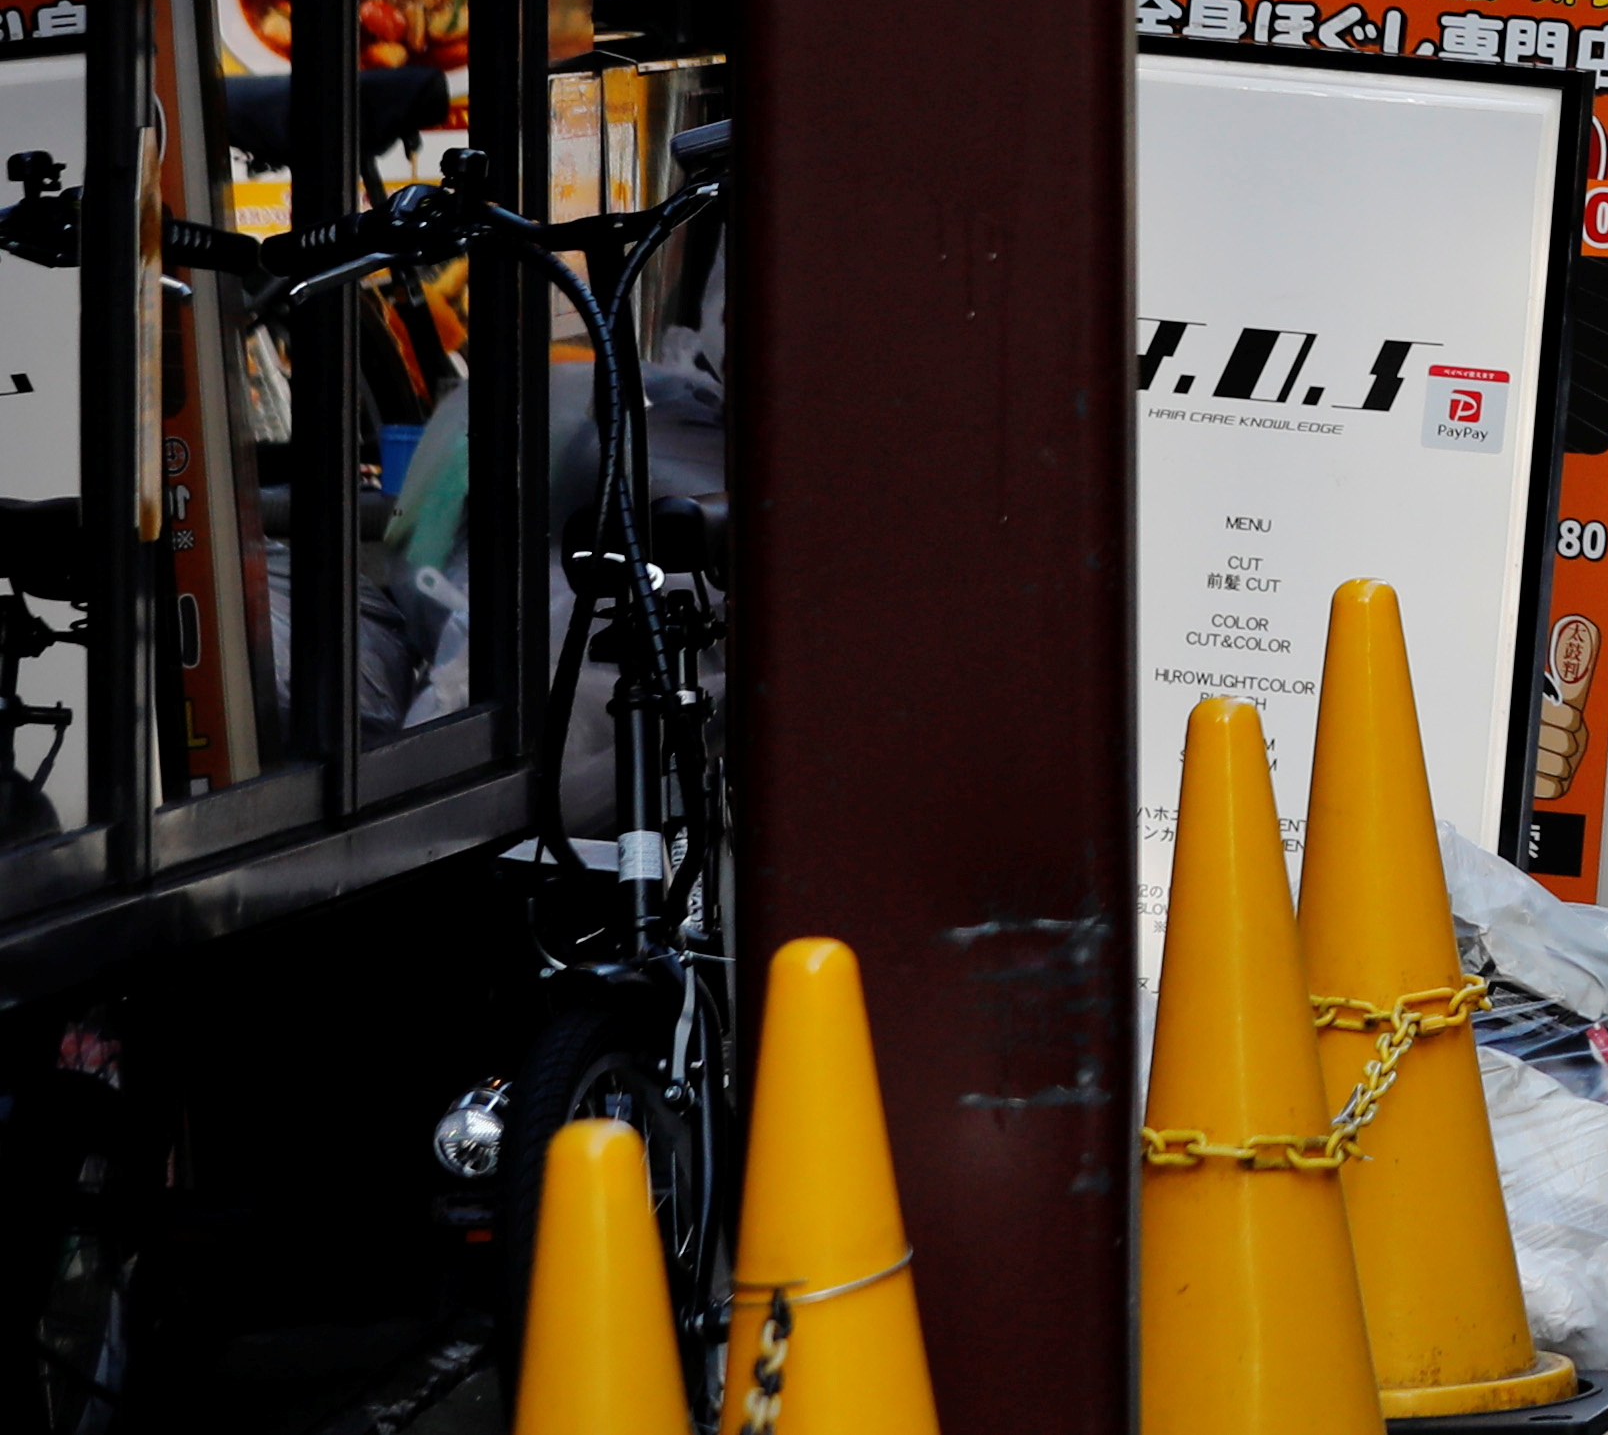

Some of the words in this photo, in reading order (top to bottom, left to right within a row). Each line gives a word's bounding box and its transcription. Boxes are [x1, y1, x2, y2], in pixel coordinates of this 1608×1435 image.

[1148, 408, 1186, 421] HAIR
[1190, 411, 1235, 426] CARE
[1239, 416, 1344, 435] KNOWLEDGE
[1437, 423, 1488, 442] PayPay
[1225, 516, 1272, 533] MENU
[1228, 556, 1264, 571] CUT
[1207, 573, 1240, 591] 前髪
[1246, 577, 1281, 592] CUT
[1211, 614, 1269, 631] COLOR
[1186, 632, 1291, 654] CUT&COLOR
[1561, 621, 1589, 680] 太鼓判
